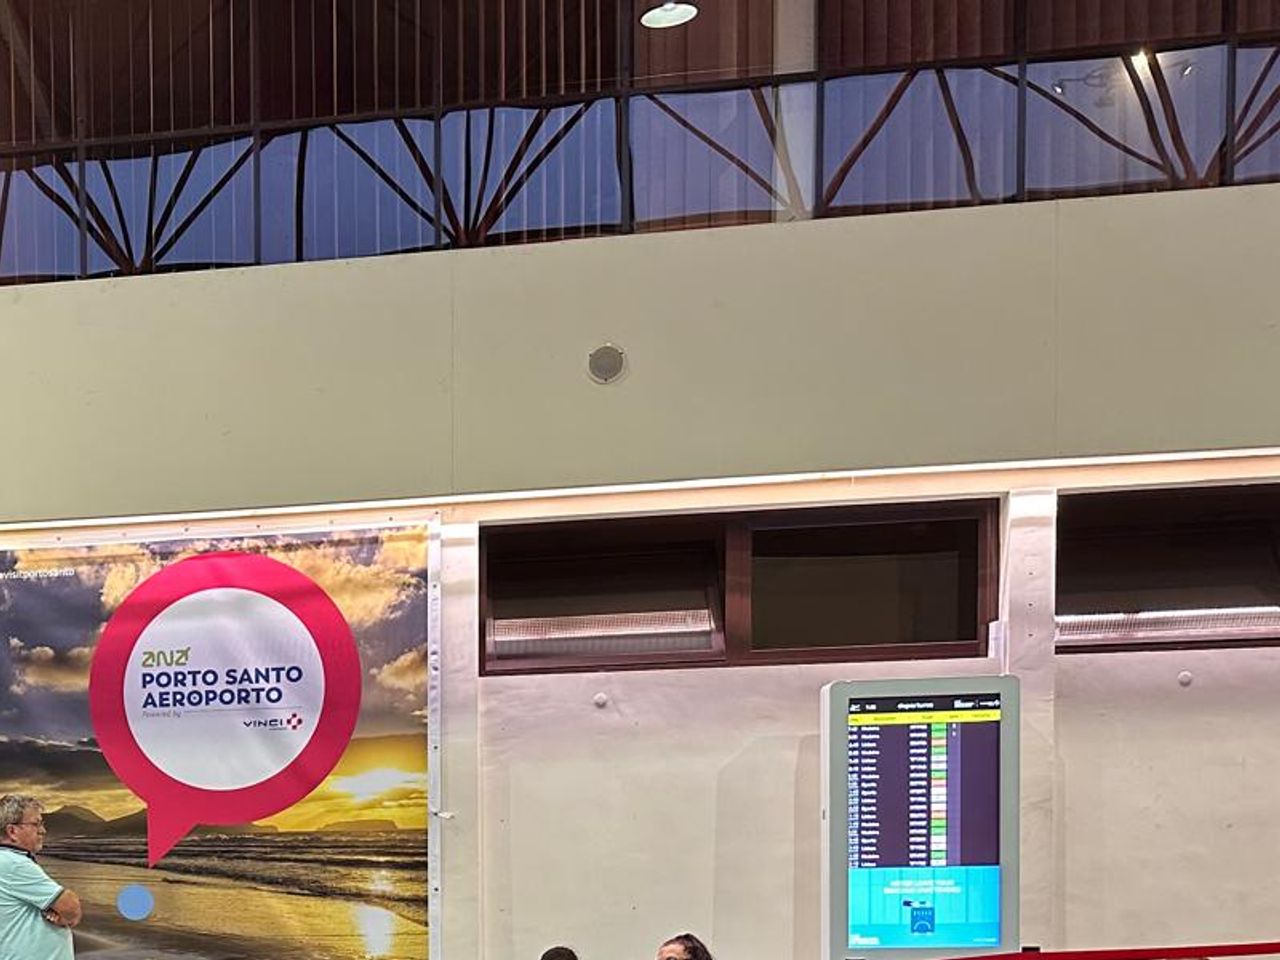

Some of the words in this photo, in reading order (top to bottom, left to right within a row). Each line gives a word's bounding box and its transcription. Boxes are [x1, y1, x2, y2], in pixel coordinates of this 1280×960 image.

[142, 669, 219, 689] PORTO
[225, 665, 303, 686] SANTO
[142, 687, 283, 709] AEROPORTO
[243, 719, 283, 728] VINCI
